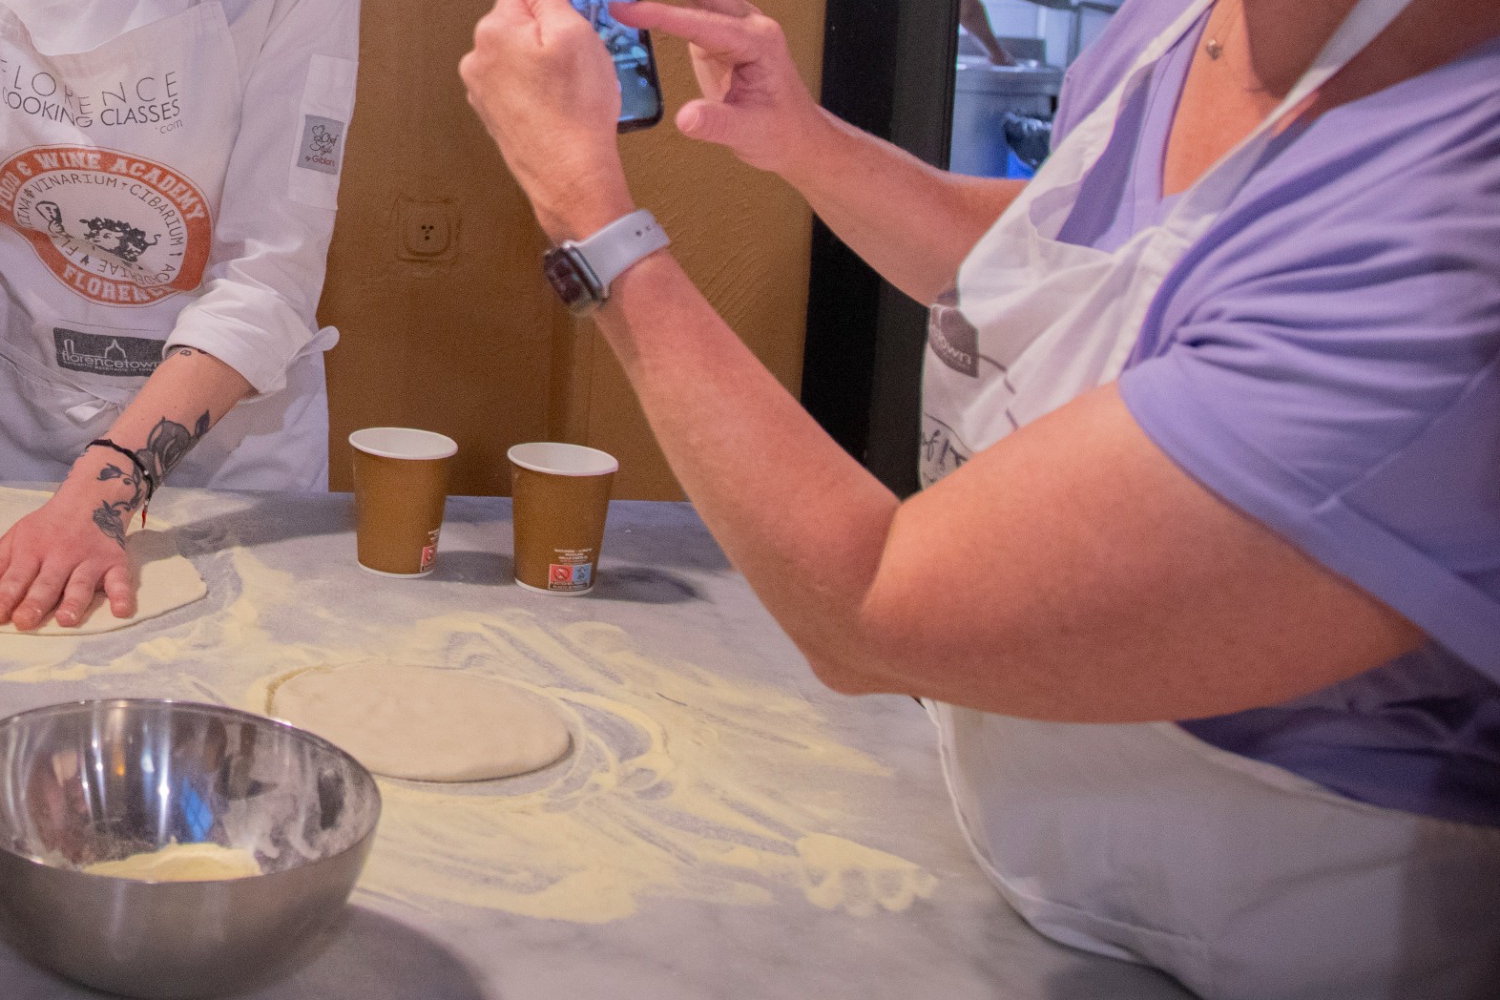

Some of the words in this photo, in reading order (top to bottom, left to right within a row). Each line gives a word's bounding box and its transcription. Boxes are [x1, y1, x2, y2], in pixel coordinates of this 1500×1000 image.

[100, 97, 181, 127] CLASSES
[31, 172, 118, 194] VINARIUM
[129, 183, 185, 247] CIBARIUM
[34, 150, 102, 170] WINE
[109, 158, 205, 221] ACADEMY
